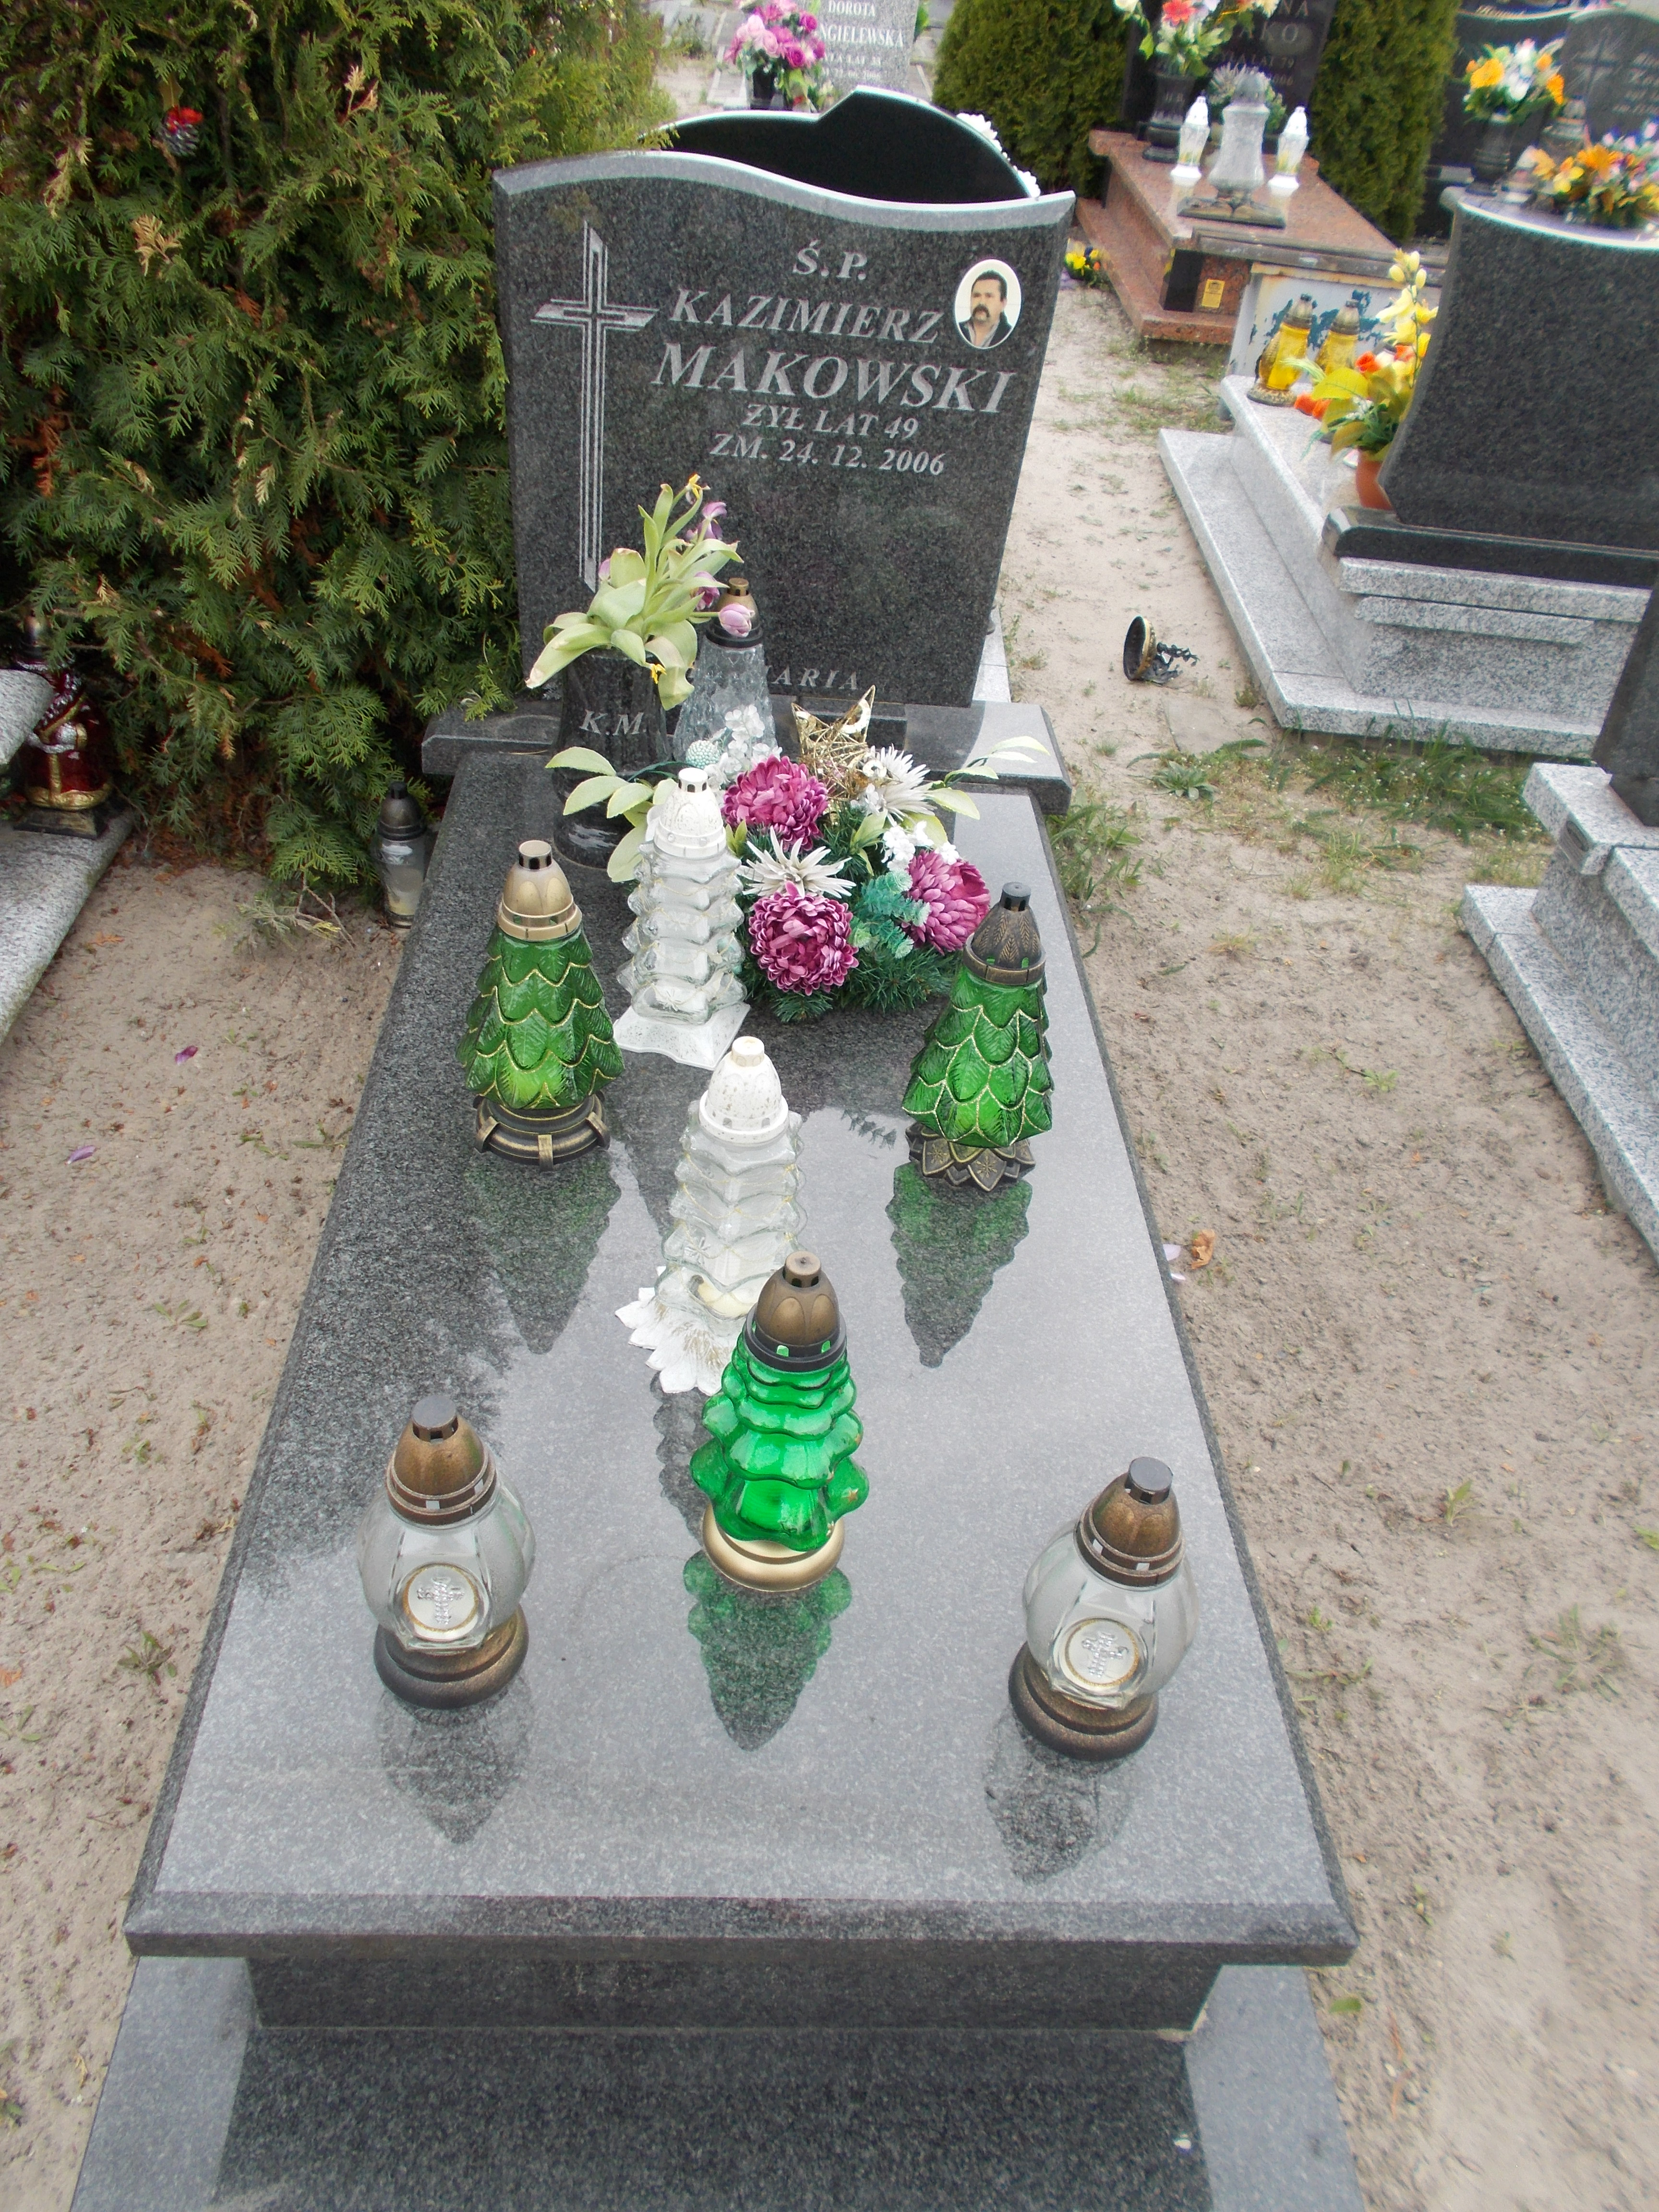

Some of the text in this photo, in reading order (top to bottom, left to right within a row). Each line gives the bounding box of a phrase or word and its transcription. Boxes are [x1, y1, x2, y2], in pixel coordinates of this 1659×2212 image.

[828, 0, 876, 17] DOROTA
[670, 288, 945, 344] KAZIMIERZ
[650, 342, 1017, 413] MAKOWSKI
[813, 409, 879, 436] LAT
[884, 416, 919, 440] 49
[709, 433, 947, 476] ZM. 24. 12. 2006
